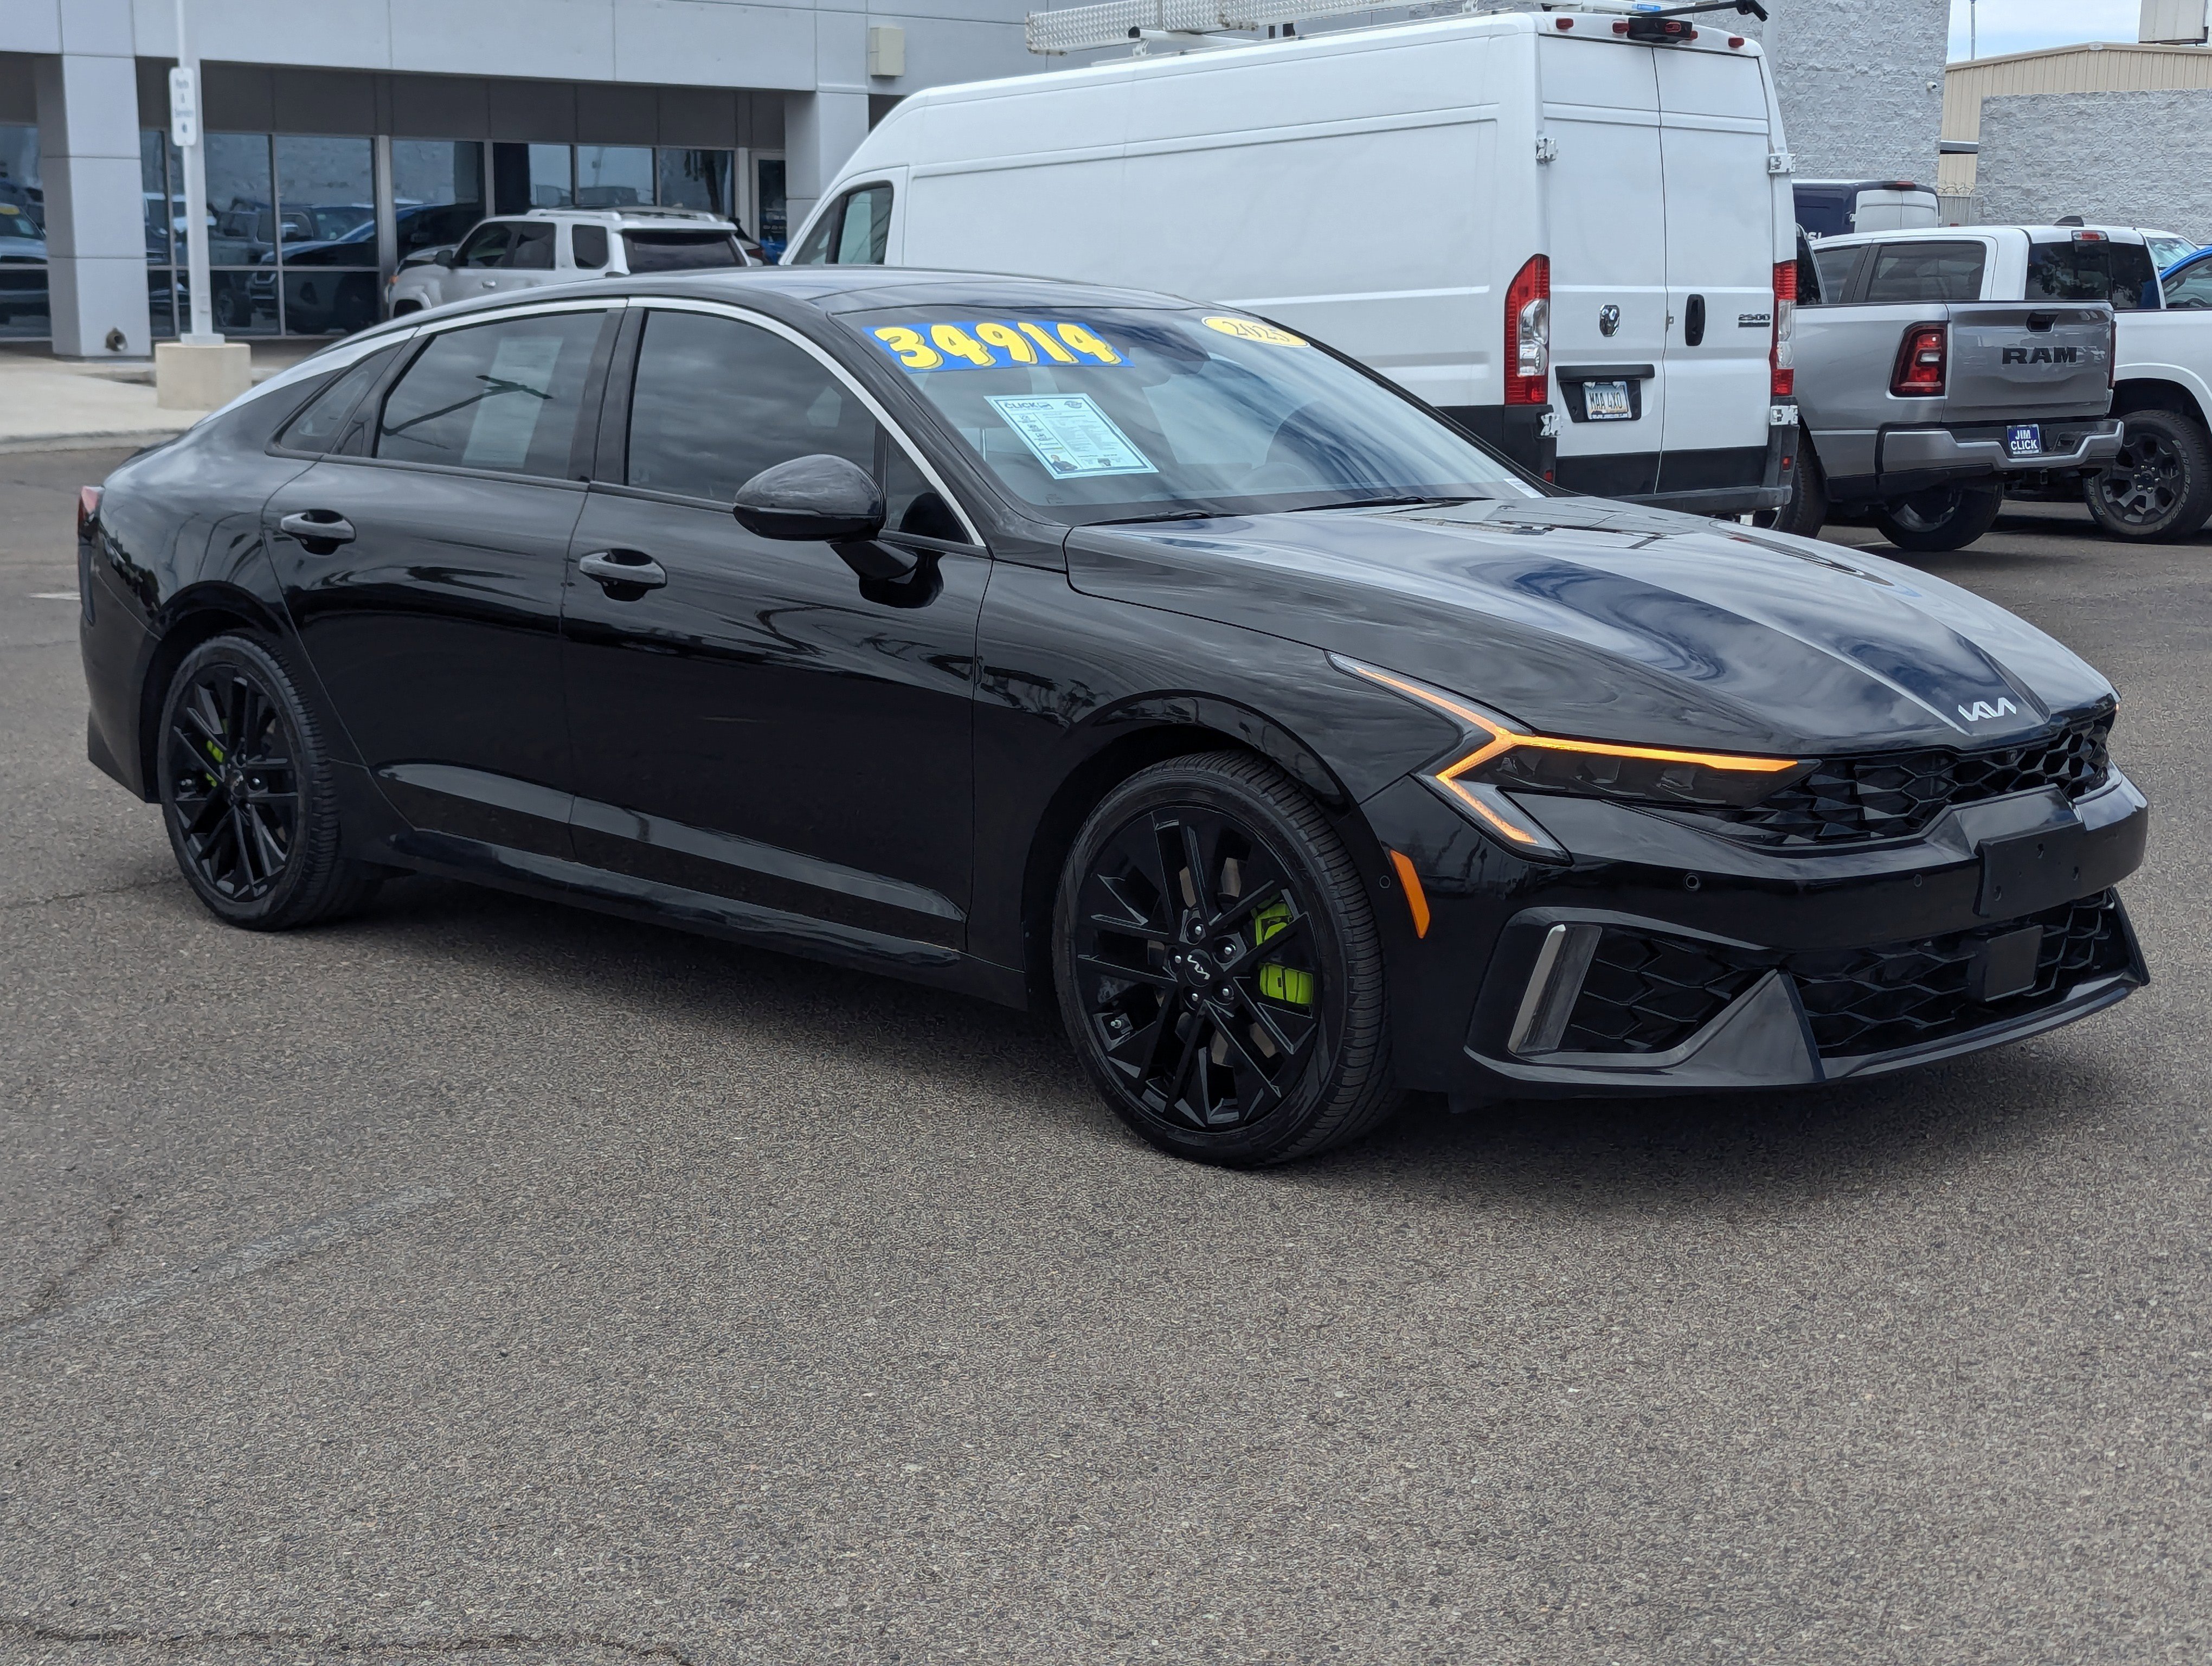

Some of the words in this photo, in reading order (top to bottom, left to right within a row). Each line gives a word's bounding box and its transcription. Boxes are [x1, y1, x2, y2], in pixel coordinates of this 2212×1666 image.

[1222, 321, 1290, 342] 2025
[874, 322, 1122, 369] 34914
[2002, 347, 2078, 364] RAM
[2015, 430, 2031, 440] JIM
[2010, 439, 2038, 451] CLICK
[1958, 697, 2017, 722] KIA
